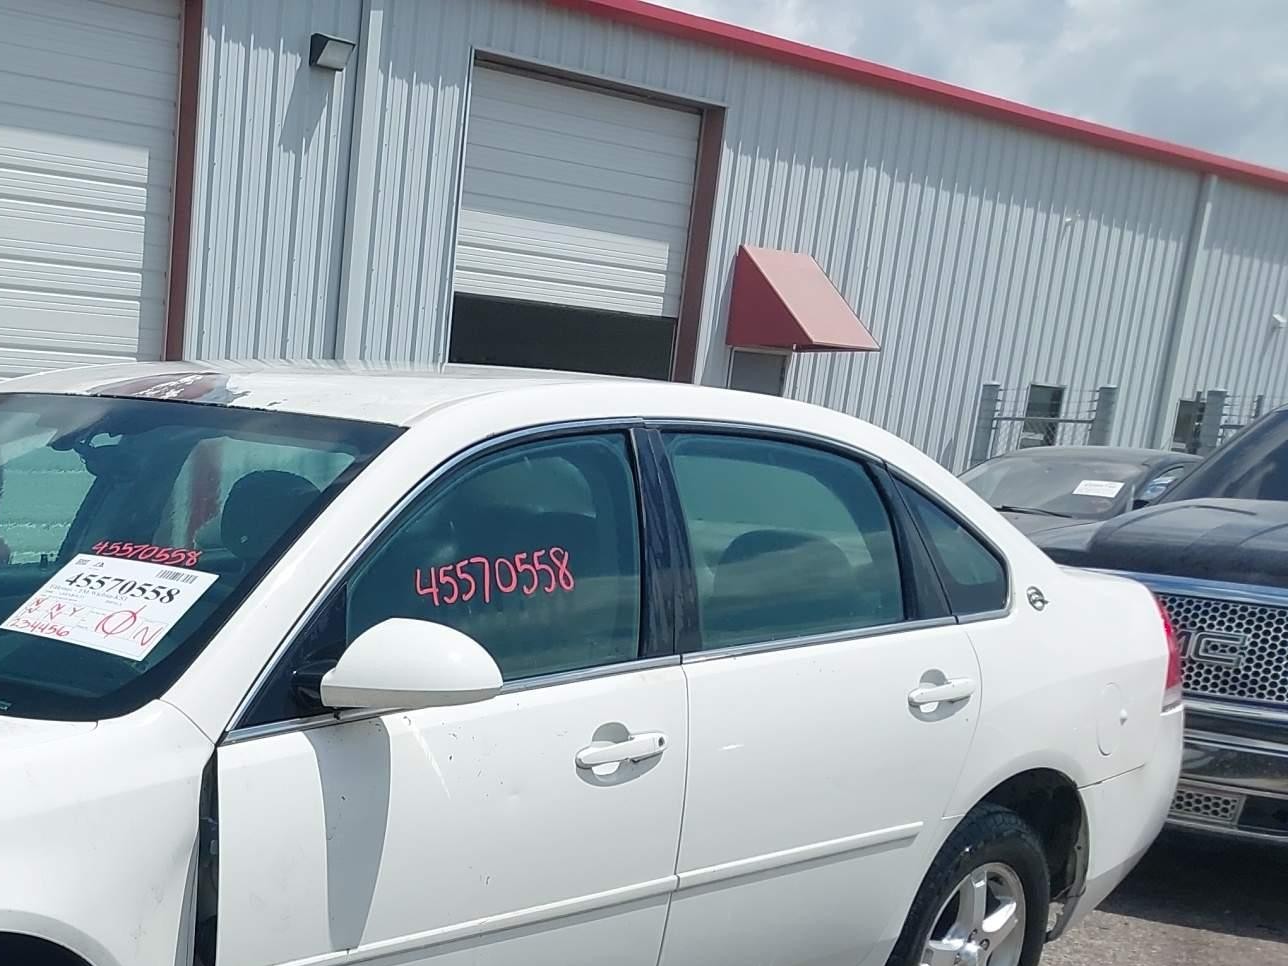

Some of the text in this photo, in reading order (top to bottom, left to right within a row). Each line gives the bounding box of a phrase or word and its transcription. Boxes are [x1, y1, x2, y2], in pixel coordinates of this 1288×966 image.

[91, 540, 203, 567] 45570558
[65, 572, 181, 605] 45570558
[415, 547, 575, 607] 45570558
[9, 618, 71, 637] 234456
